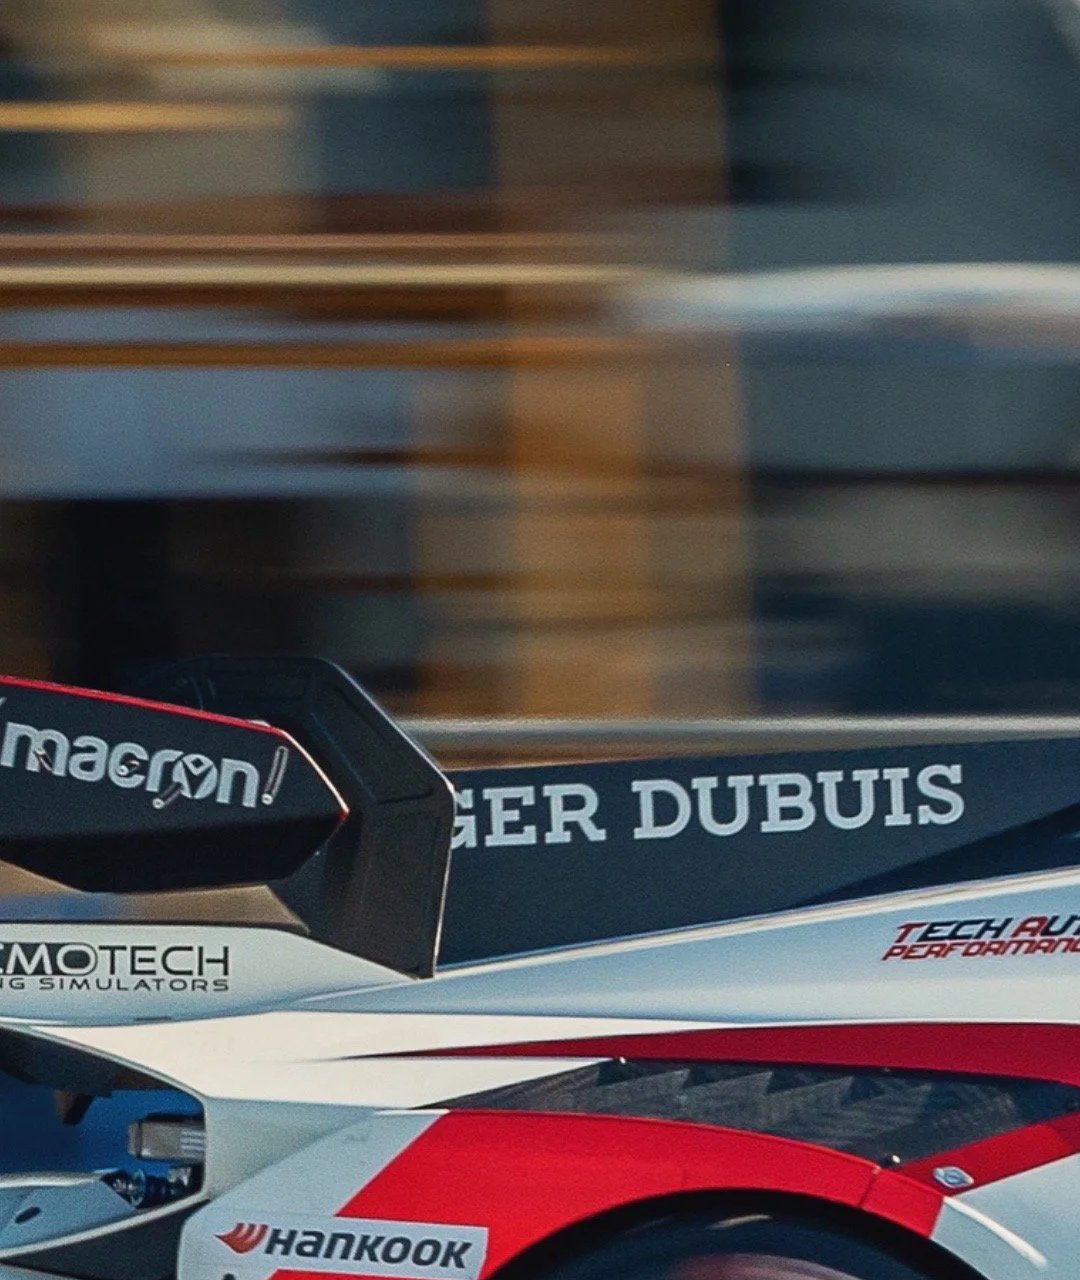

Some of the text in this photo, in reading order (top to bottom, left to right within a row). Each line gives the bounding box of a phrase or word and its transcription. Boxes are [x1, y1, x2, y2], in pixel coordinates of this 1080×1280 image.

[0, 721, 260, 808] macron
[632, 764, 965, 839] DUBUIS
[895, 918, 1014, 943] TECH
[0, 943, 230, 976] MOTECH
[39, 977, 230, 992] SIMULATORS
